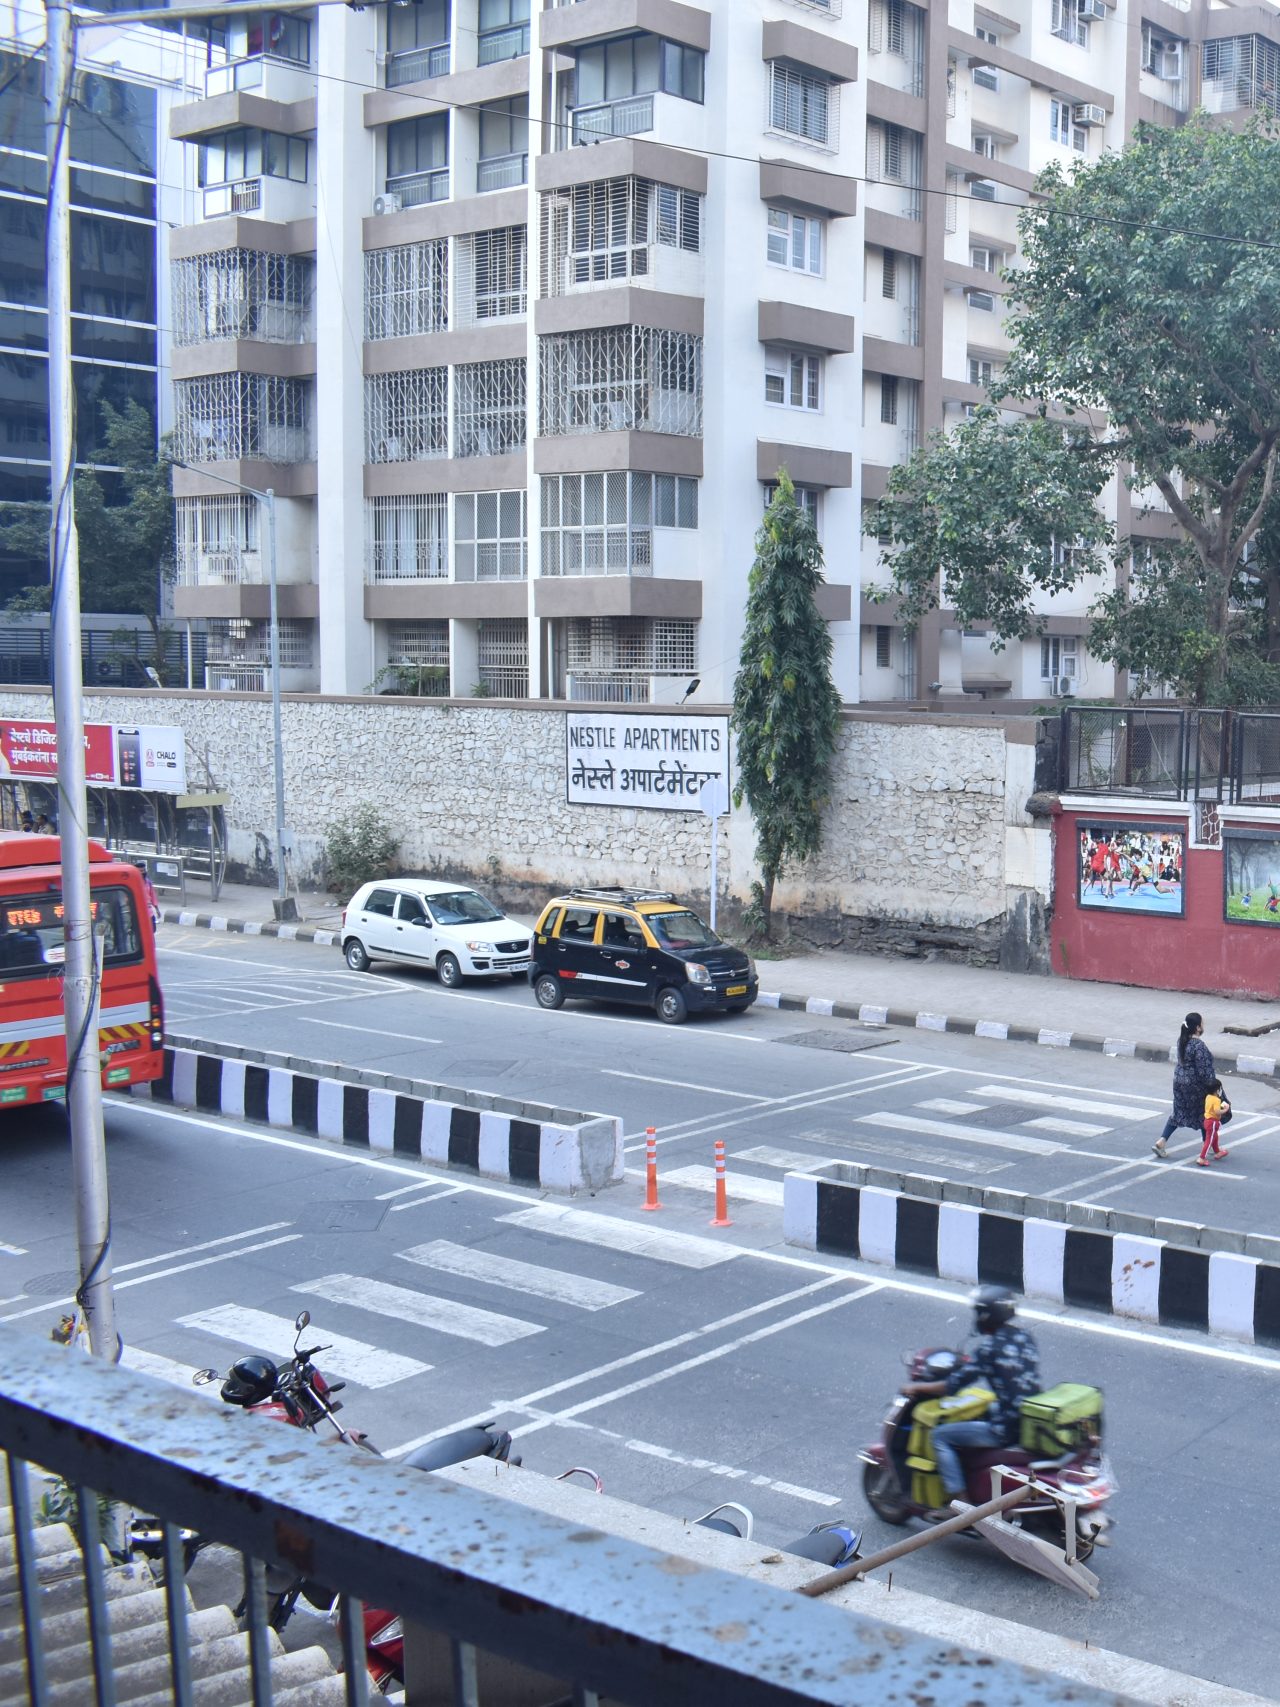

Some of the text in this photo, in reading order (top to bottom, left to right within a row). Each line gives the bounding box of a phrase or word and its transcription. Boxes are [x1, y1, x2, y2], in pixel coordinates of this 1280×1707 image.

[570, 726, 720, 751] NESTLE APARTMENTS
[156, 751, 177, 760] CHALO
[572, 759, 616, 790] नेस्ले
